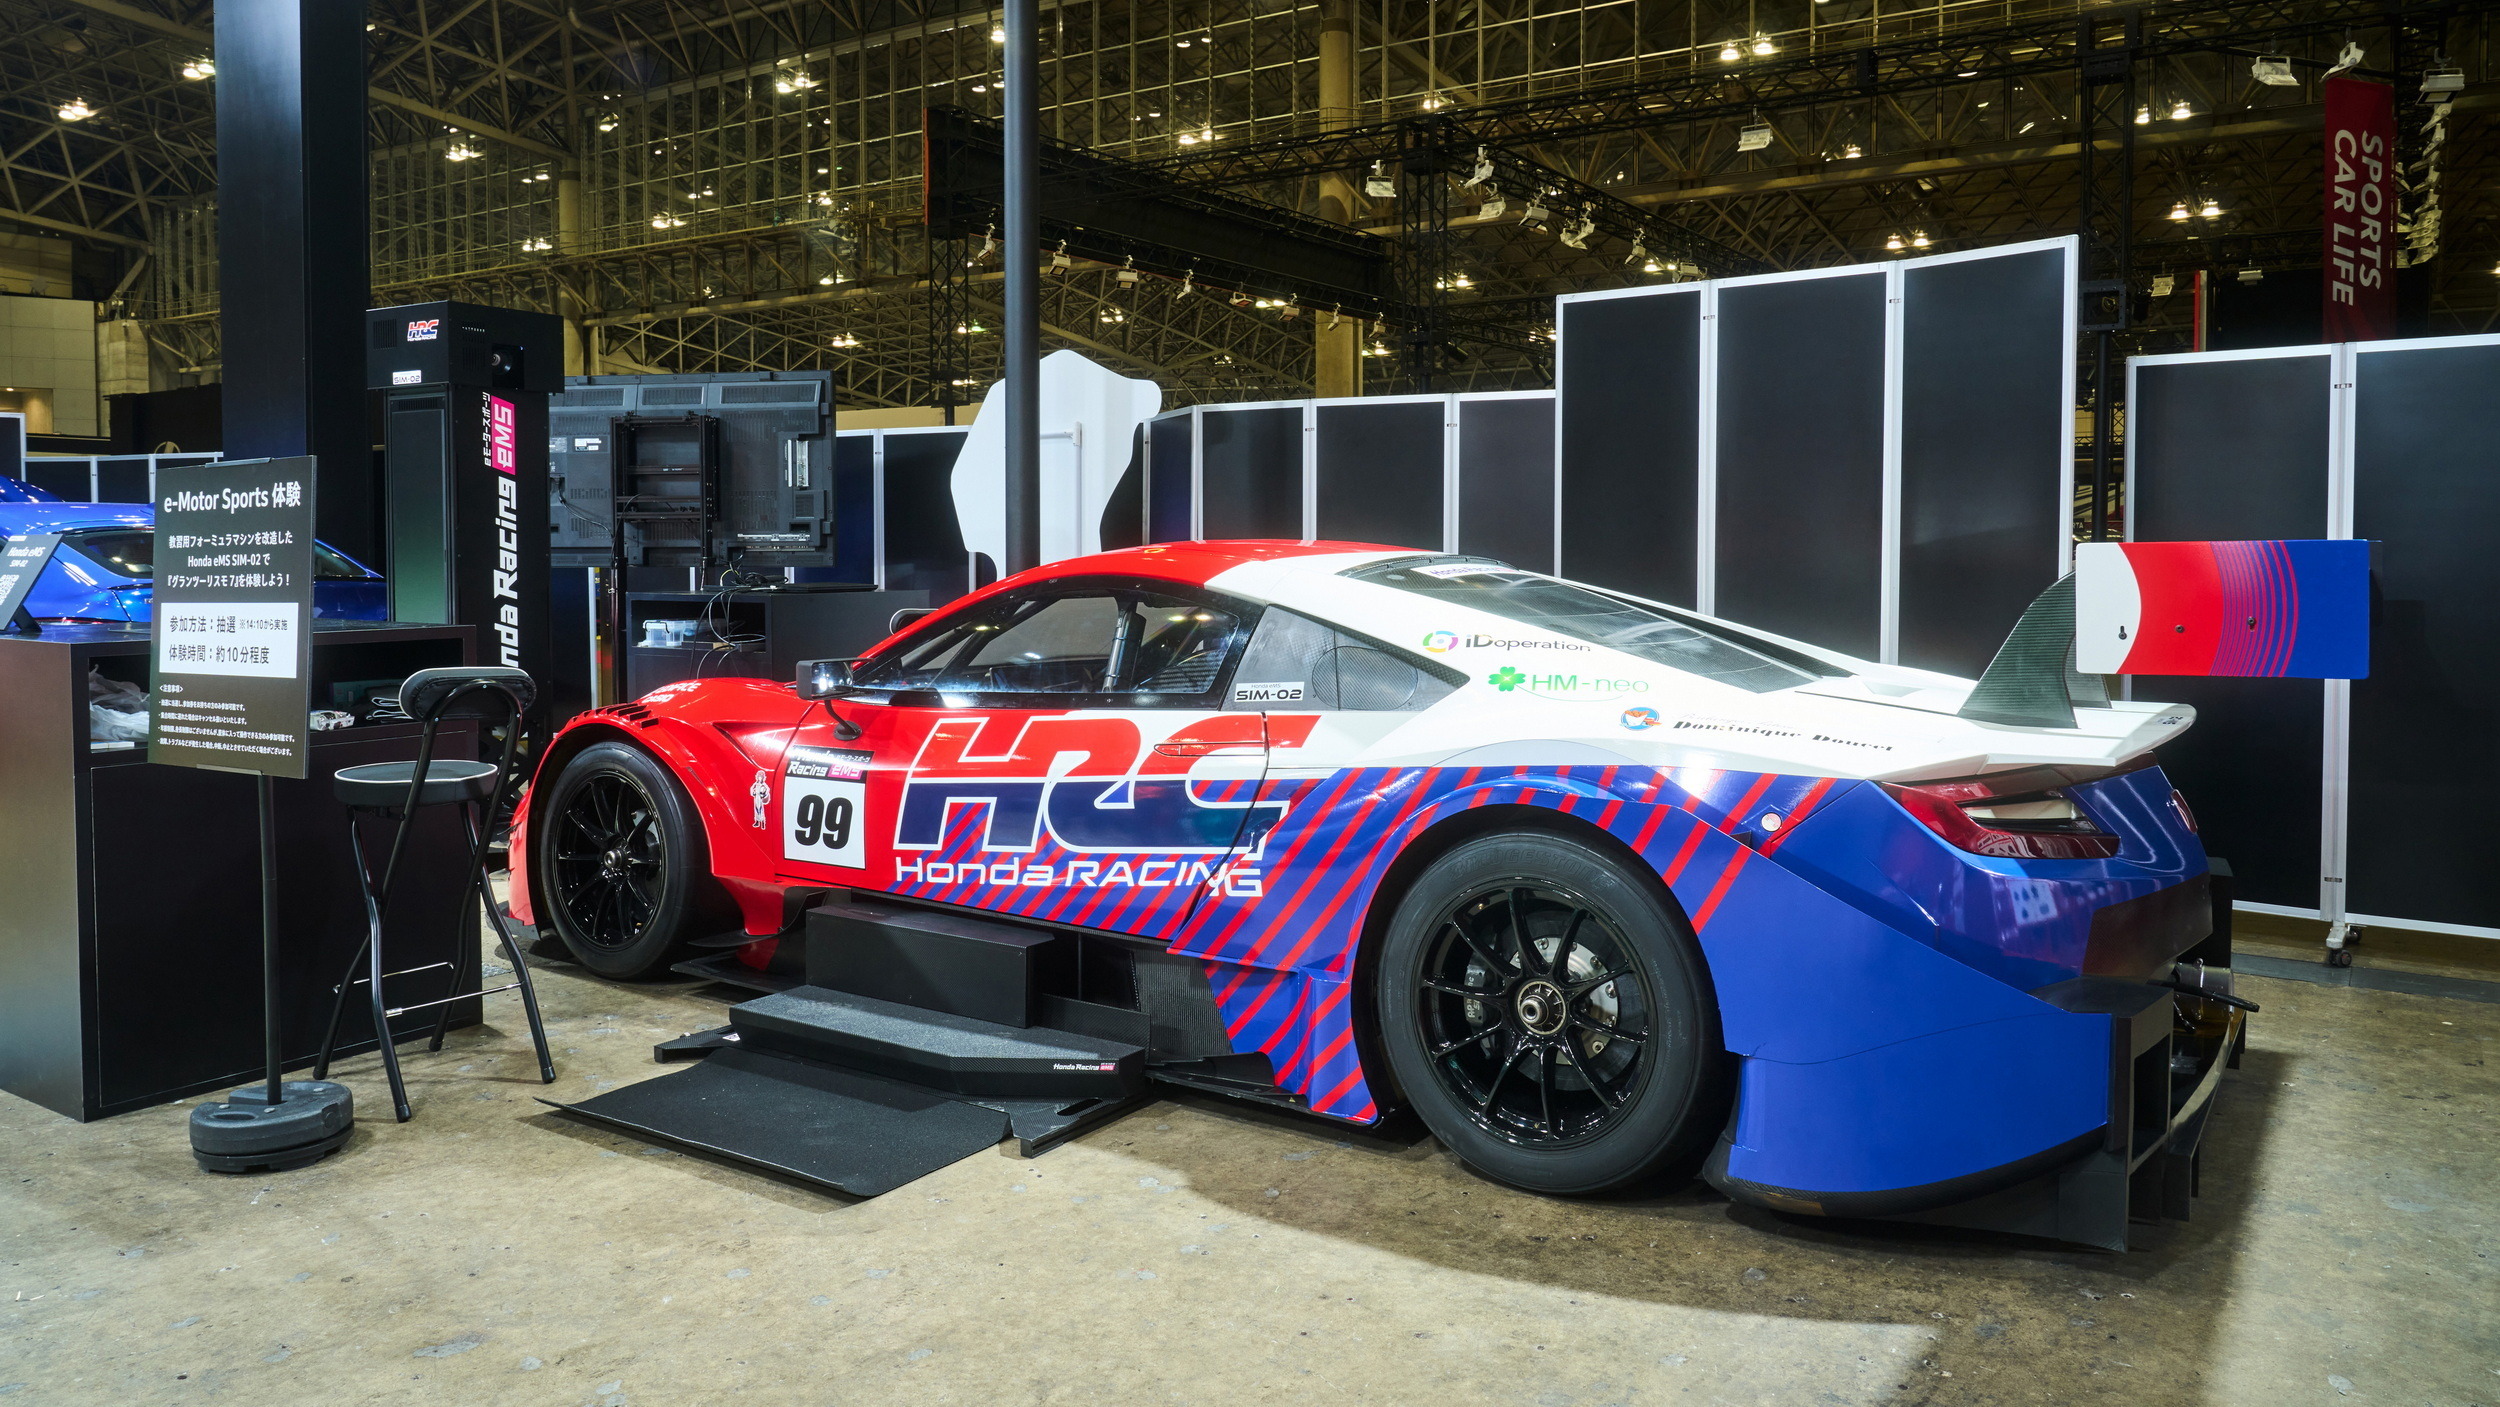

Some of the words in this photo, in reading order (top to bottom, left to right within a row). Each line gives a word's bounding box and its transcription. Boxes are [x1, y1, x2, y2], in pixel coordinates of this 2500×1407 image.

[2333, 129, 2357, 213] CAR
[2359, 130, 2383, 289] SPORTS
[2332, 222, 2355, 306] LIFE
[407, 319, 439, 338] HRC
[394, 375, 420, 384] SIM-02
[495, 403, 513, 468] eMS
[163, 490, 220, 513] e-Motor
[222, 487, 269, 514] Sports
[272, 481, 301, 508] 体験
[168, 530, 293, 549] 教習用フォーミュラマシンを改造した
[493, 475, 518, 600] Racing
[188, 555, 212, 567] Honda
[213, 554, 230, 567] eMS
[231, 553, 261, 566] SIM-02
[494, 604, 519, 668] nda
[1236, 689, 1302, 701] SIM-02
[1531, 674, 1649, 693] HM-neo
[1673, 720, 1802, 738] Dominique
[787, 761, 828, 776] Racing
[893, 713, 1322, 860] HRC
[795, 794, 853, 850] 99
[895, 856, 1054, 886] Honda
[1066, 860, 1263, 897] RACING
